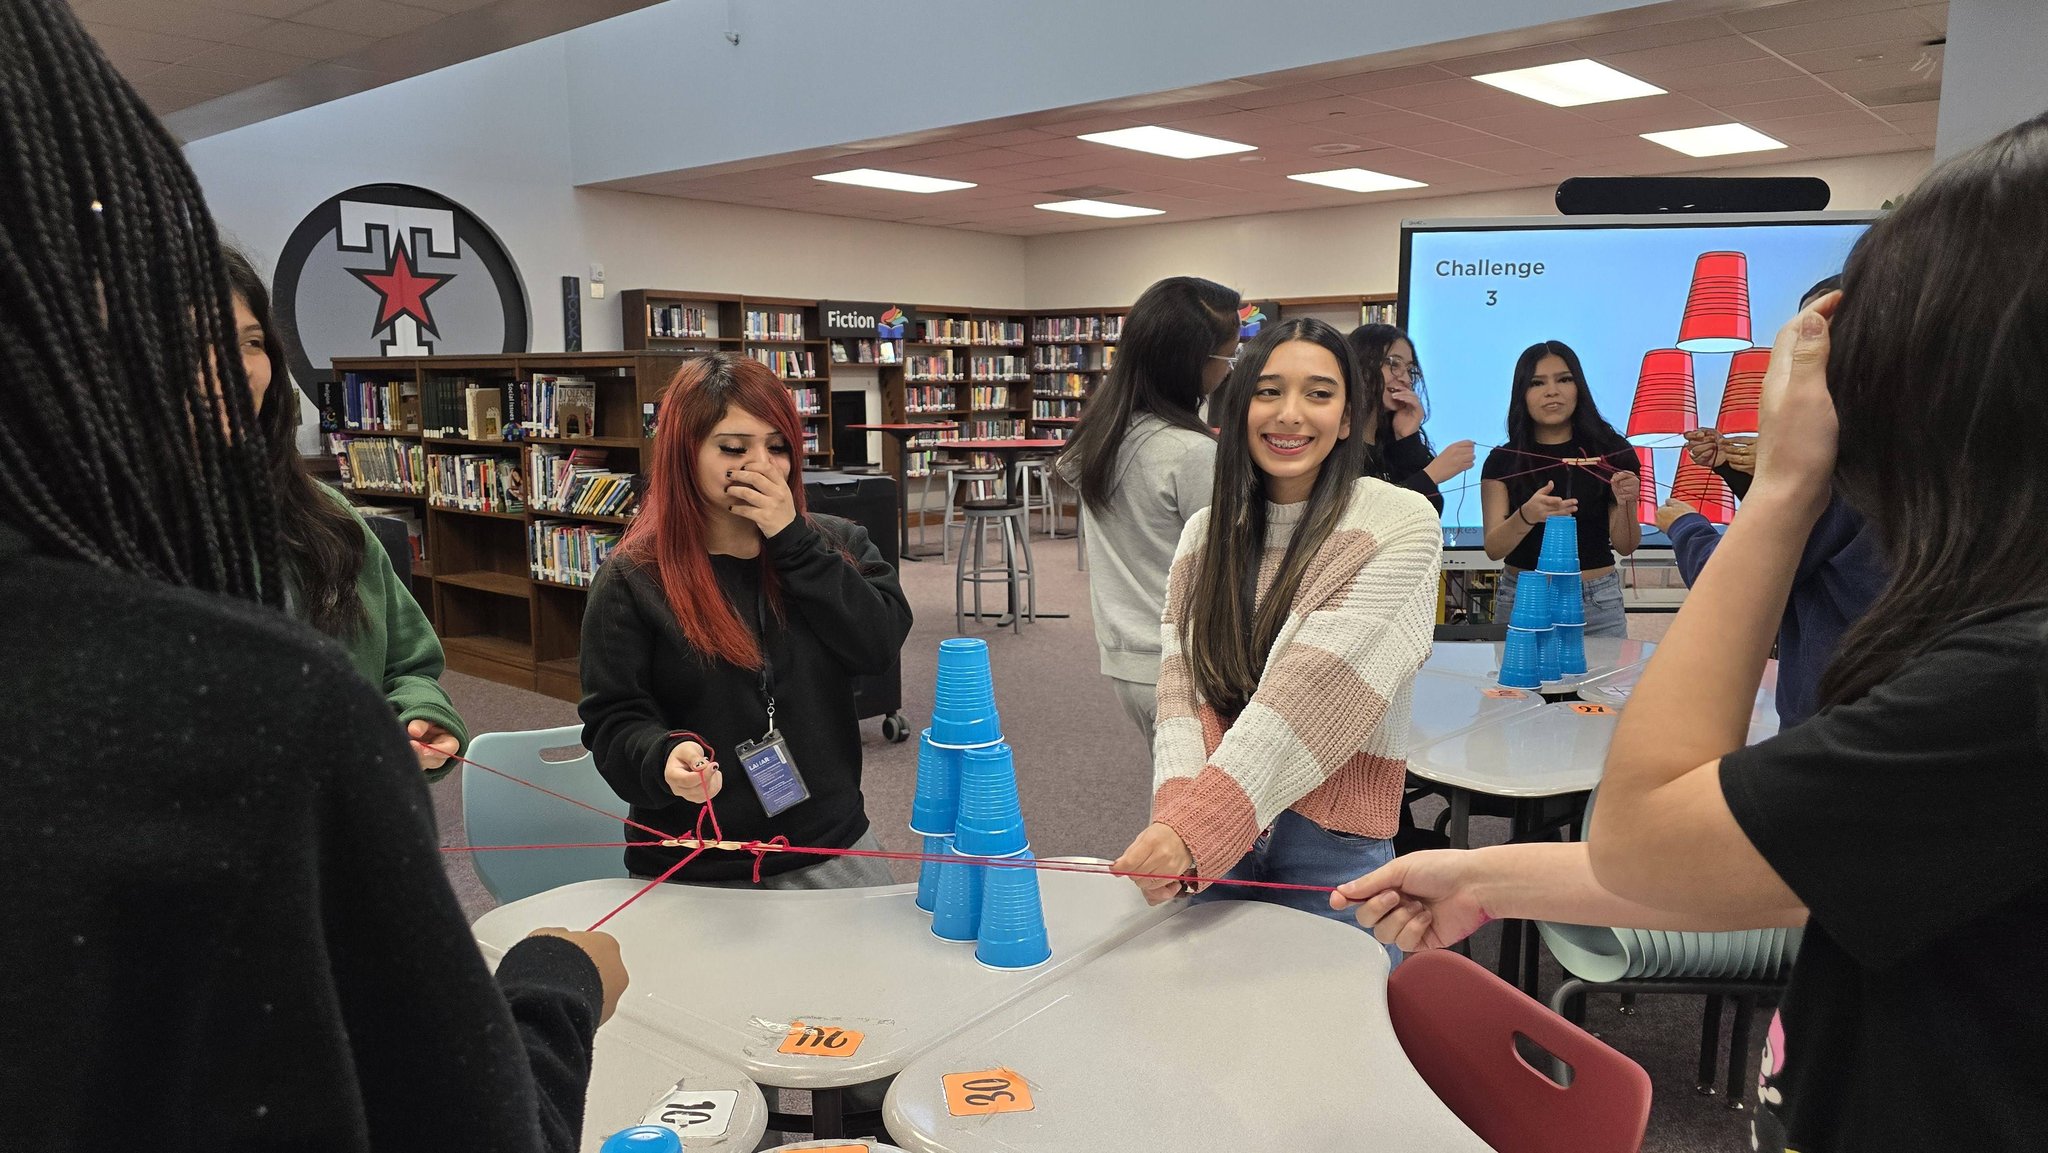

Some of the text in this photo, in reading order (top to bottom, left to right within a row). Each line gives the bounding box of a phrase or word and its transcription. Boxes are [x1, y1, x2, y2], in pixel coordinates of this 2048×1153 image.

[1436, 259, 1545, 278] Challenge
[1486, 290, 1498, 306] 3
[827, 310, 875, 329] Fiction
[962, 1078, 1016, 1106] 30
